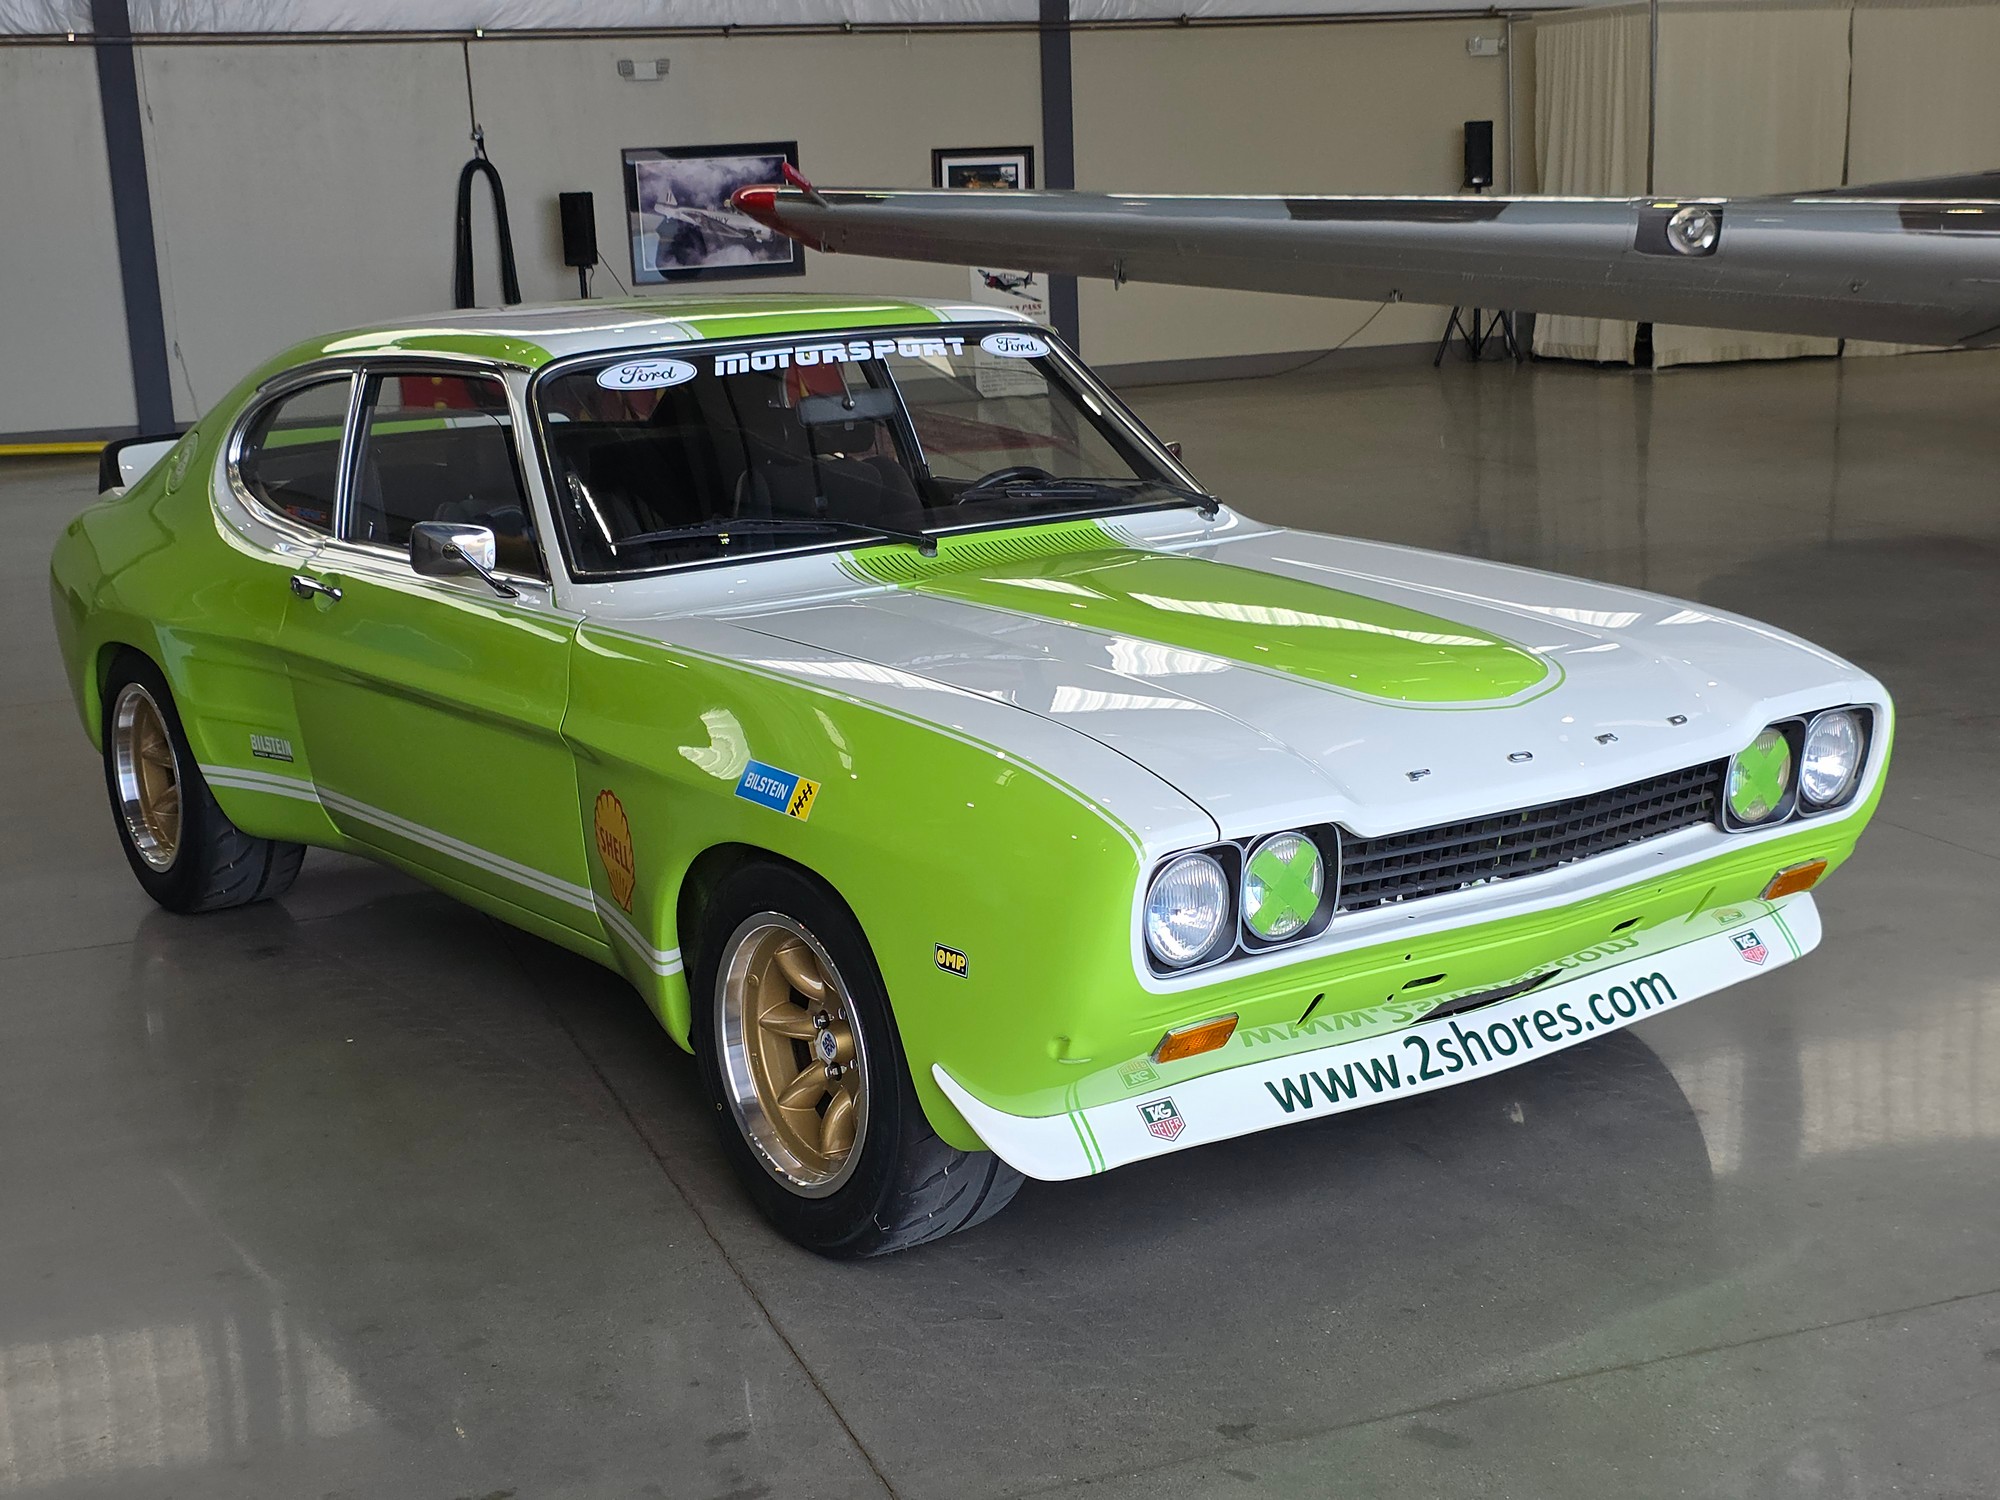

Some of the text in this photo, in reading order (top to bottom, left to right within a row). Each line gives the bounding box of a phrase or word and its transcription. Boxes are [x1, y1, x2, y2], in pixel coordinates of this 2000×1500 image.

[995, 337, 1038, 352] Ford
[714, 337, 965, 377] MOTORSPORT
[620, 364, 677, 385] Ford
[250, 734, 292, 757] BILSTEIN
[744, 772, 789, 801] BILSTEIN
[600, 826, 631, 874] SHELL
[1735, 934, 1757, 949] TAG
[1264, 971, 1678, 1114] www.2shores.com
[1146, 1103, 1172, 1121] TAG
[1150, 1117, 1182, 1137] HEUER
